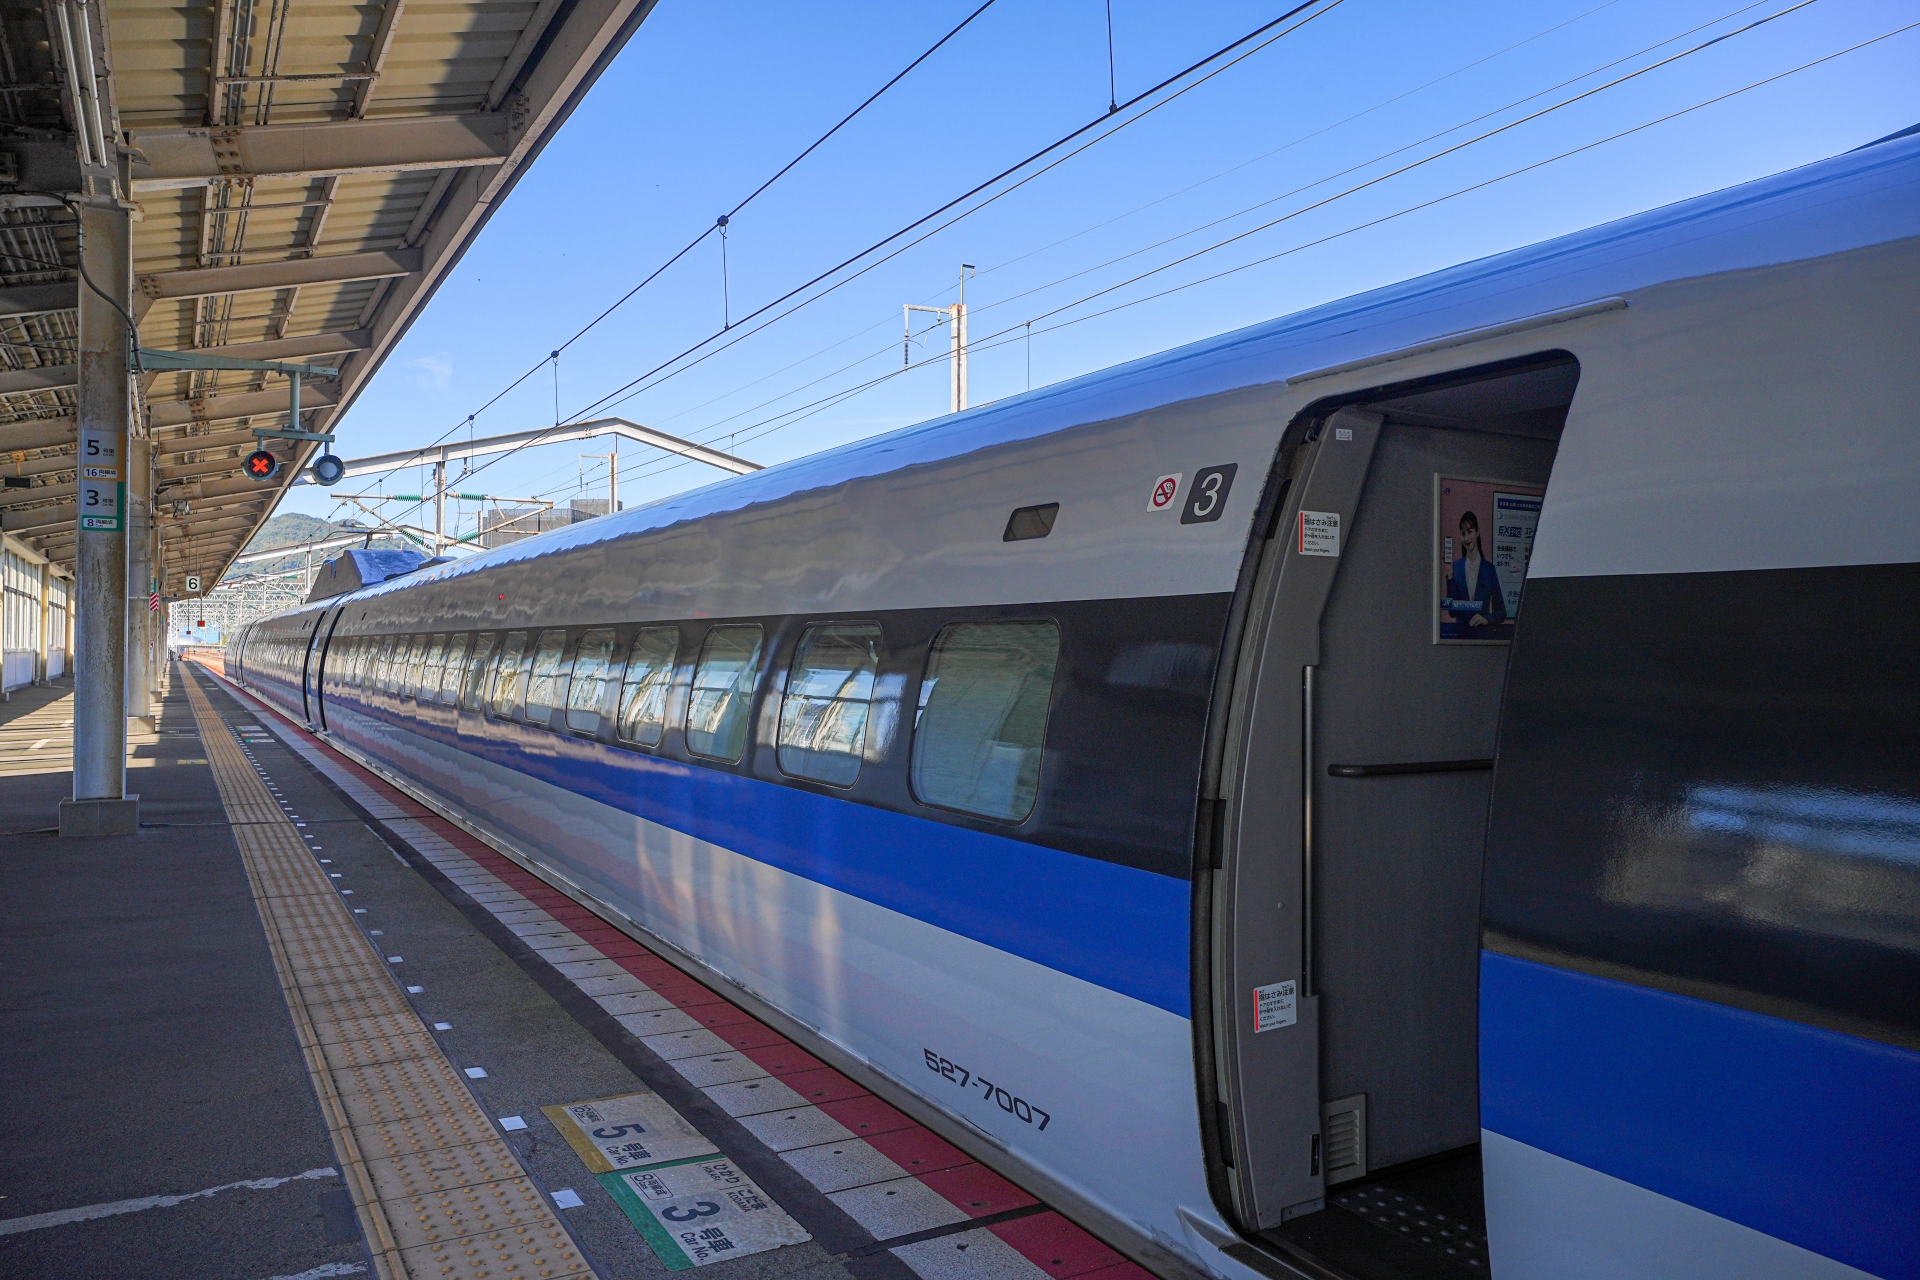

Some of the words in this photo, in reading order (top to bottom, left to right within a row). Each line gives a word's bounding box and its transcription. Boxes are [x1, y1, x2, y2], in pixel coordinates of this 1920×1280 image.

[87, 440, 100, 456] 5
[86, 469, 97, 477] 16
[86, 490, 99, 506] 3
[1193, 472, 1223, 516] 3
[1304, 518, 1338, 527] 指はさみ注意
[188, 578, 198, 590] 6
[1259, 987, 1294, 1001] 指はさみ注意
[923, 1048, 1051, 1132] 527-7007
[592, 1124, 646, 1138] 5
[622, 1142, 652, 1160] 号車
[614, 1155, 629, 1165] No.
[634, 1173, 654, 1182] 8
[713, 1164, 740, 1184] ひかり
[738, 1188, 768, 1210] こだま
[727, 1191, 752, 1212] KODAMA
[662, 1201, 721, 1221] 3
[699, 1227, 736, 1252] 号車
[681, 1232, 698, 1247] Car
[692, 1246, 708, 1261] No.
